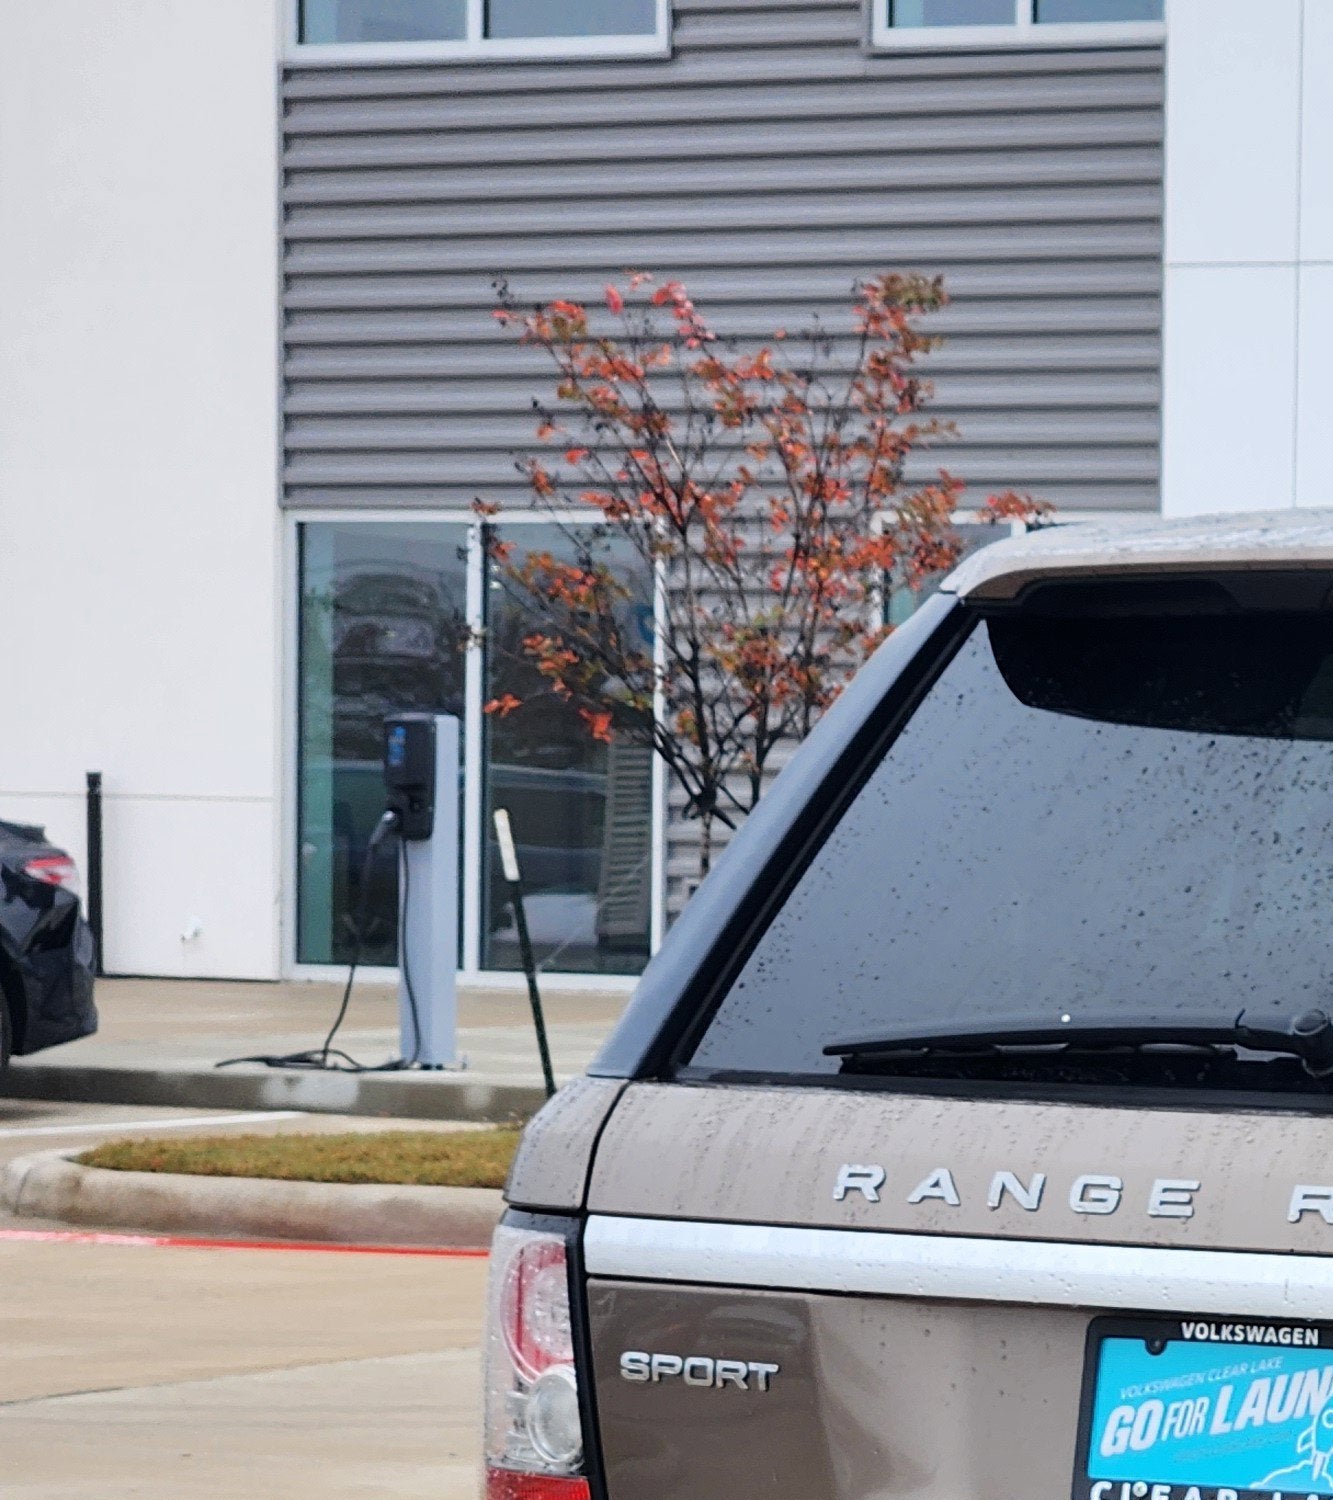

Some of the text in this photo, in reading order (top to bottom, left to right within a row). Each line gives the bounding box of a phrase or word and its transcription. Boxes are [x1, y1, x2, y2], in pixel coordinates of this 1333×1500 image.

[831, 1163, 1201, 1219] RANGE
[1181, 1321, 1319, 1346] VOLKSWAGEN
[619, 1350, 781, 1393] SPORT
[1120, 1355, 1285, 1400] VOLKSWAGEN CLEAR LAKE
[1100, 1399, 1164, 1457] GO
[1161, 1396, 1210, 1441] FOR
